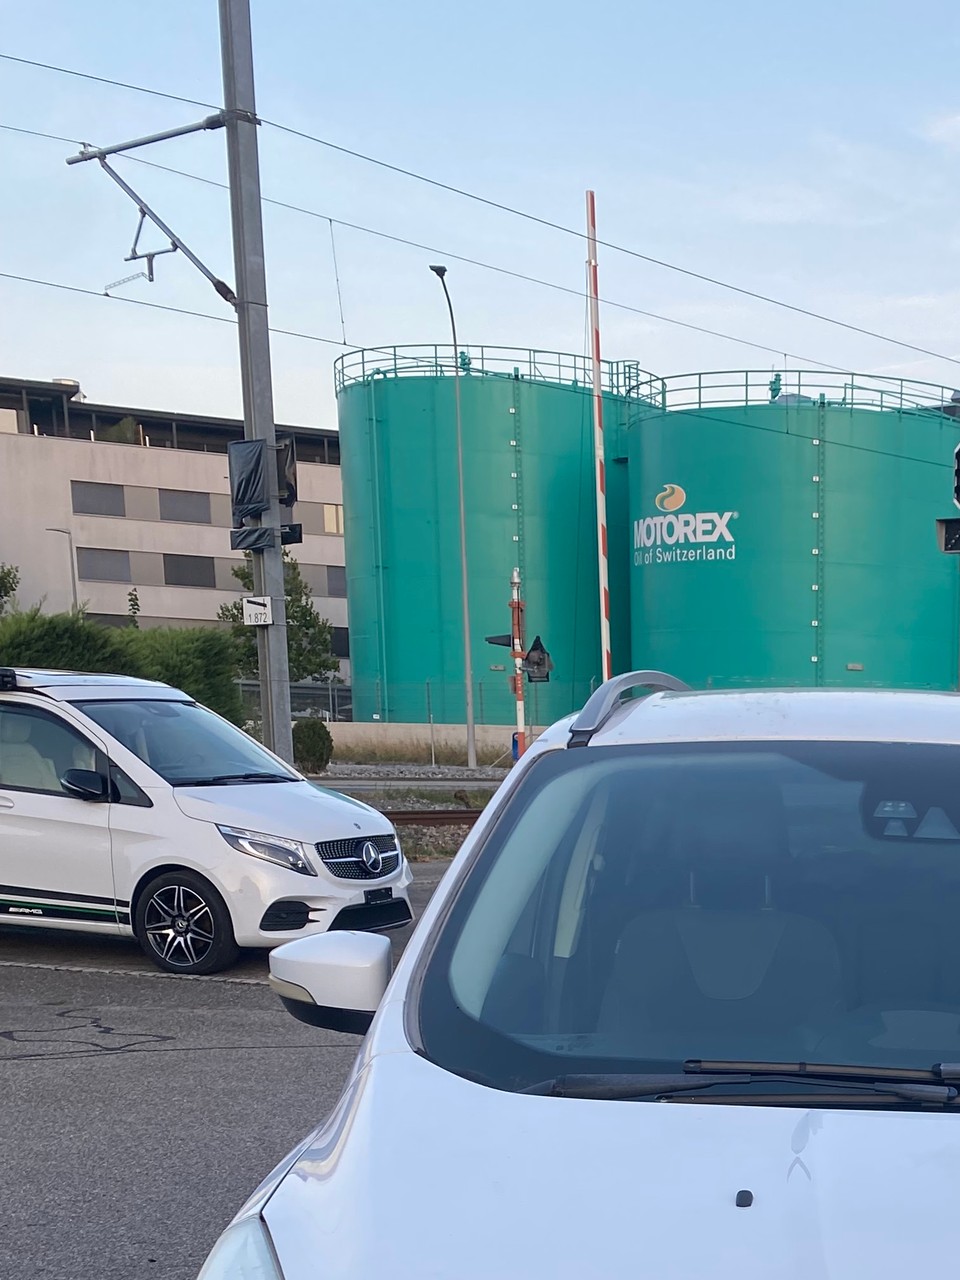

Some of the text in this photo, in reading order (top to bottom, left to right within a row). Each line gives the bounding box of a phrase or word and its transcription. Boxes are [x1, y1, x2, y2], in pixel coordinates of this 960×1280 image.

[634, 512, 734, 549] MOTOREX
[644, 549, 653, 564] of
[656, 545, 736, 563] Switzerland
[248, 612, 268, 624] 1.872
